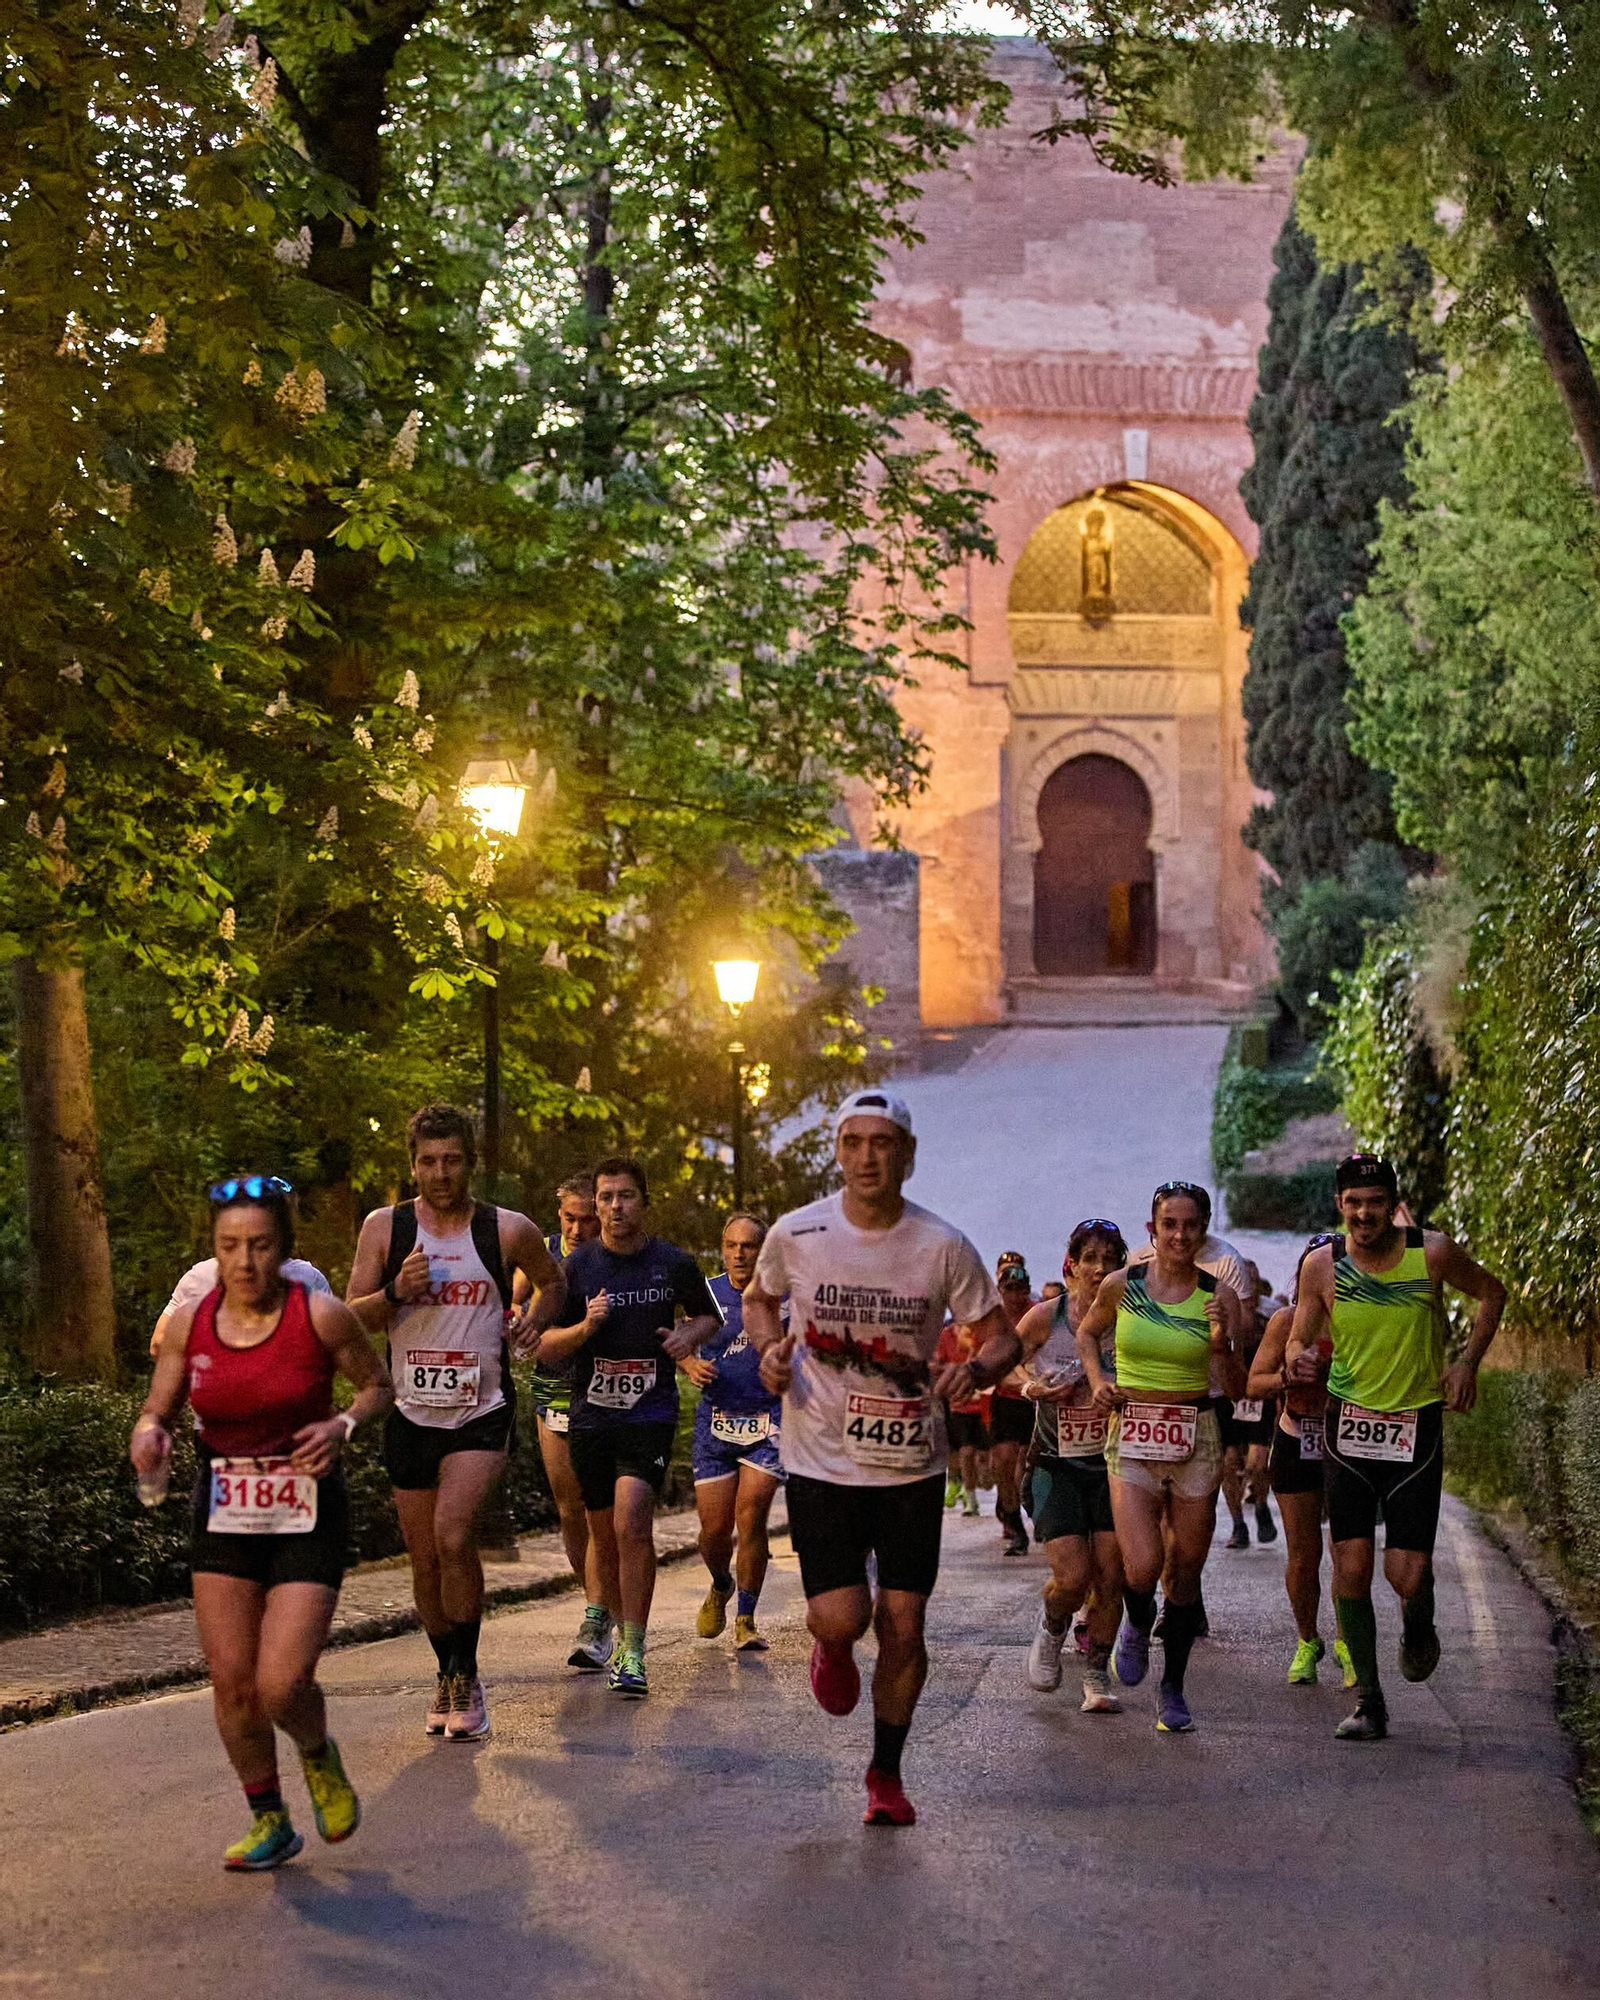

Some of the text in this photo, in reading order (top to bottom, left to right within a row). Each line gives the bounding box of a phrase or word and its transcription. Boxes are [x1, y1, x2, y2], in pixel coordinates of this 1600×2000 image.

[815, 1284, 837, 1306] 40
[839, 1294, 877, 1308] MEDIA
[815, 1306, 856, 1322] CIUDAD
[860, 1309, 875, 1324] DE
[413, 1367, 458, 1390] 873
[591, 1374, 645, 1395] 2169
[713, 1419, 758, 1434] 6378
[847, 1416, 930, 1447] 4482
[1121, 1420, 1183, 1446] 2960
[1340, 1419, 1403, 1445] 2987
[215, 1478, 298, 1508] 3184
